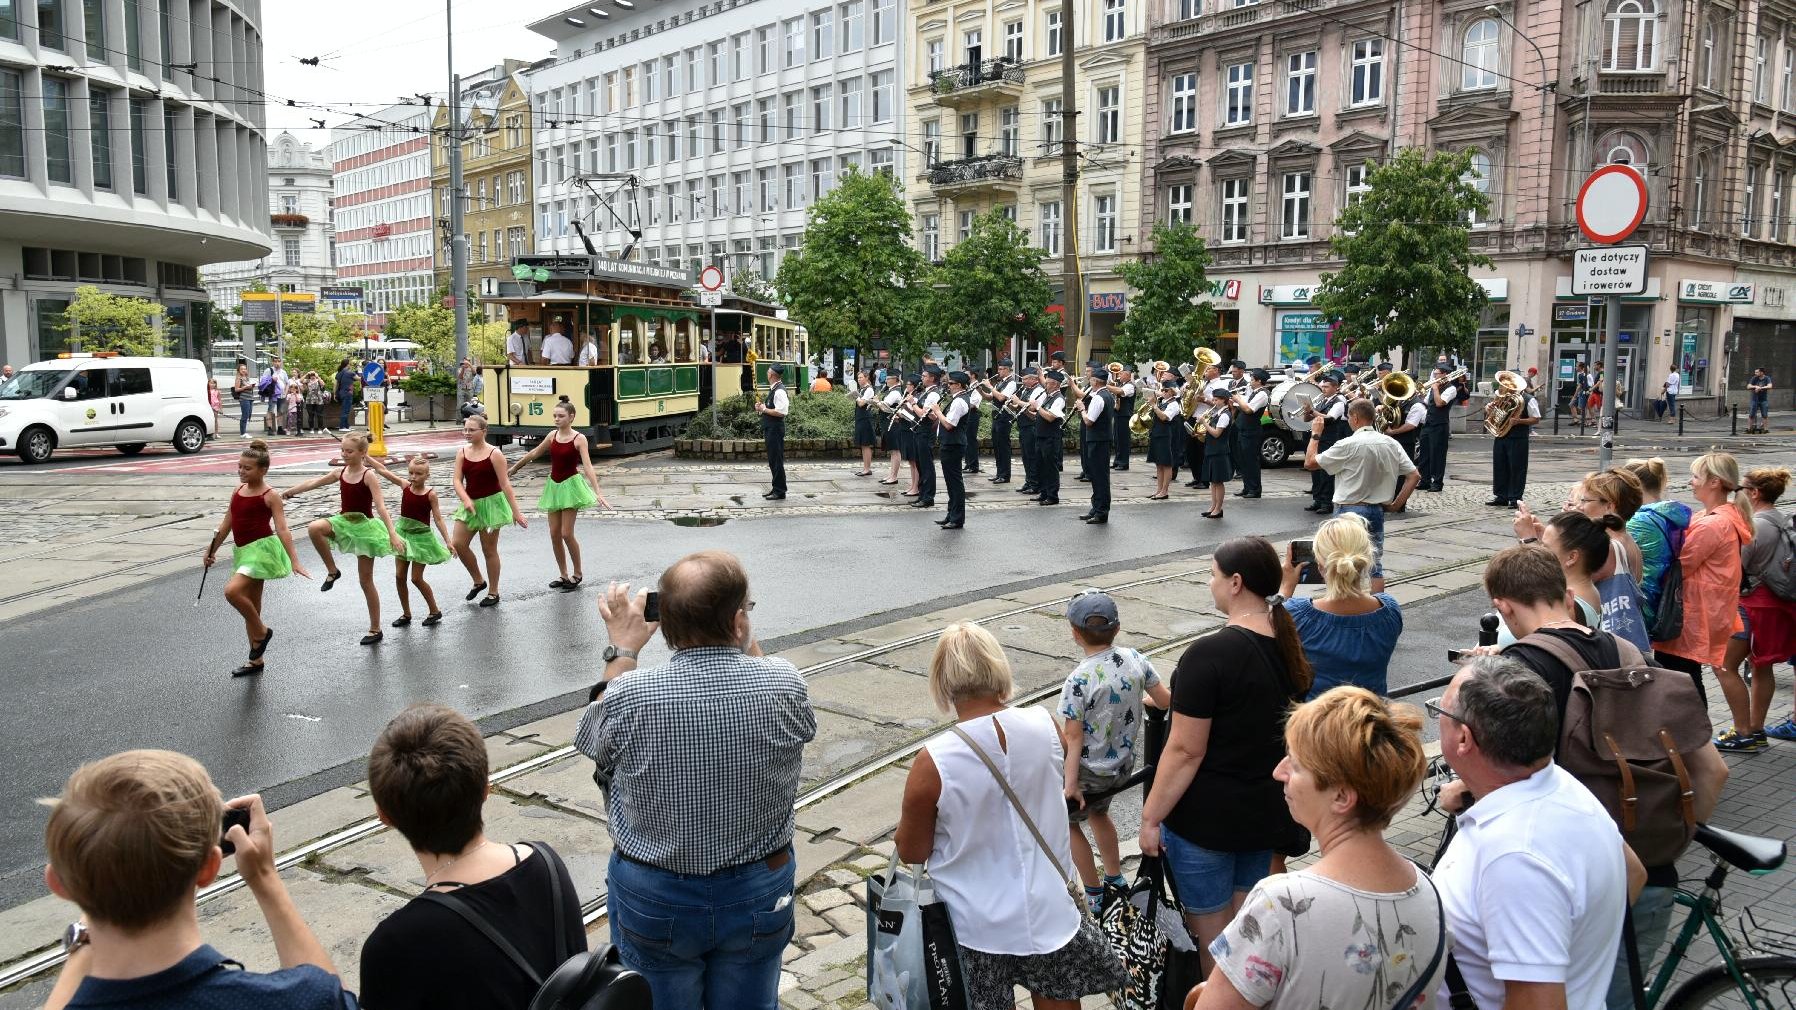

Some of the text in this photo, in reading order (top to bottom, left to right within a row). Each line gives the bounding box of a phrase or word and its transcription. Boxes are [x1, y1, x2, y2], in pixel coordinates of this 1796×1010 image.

[1580, 252, 1640, 265] Nie dotyczy
[597, 260, 607, 272] 140
[608, 261, 617, 273] LAT
[1590, 266, 1627, 277] dostaw
[486, 276, 492, 294] 1
[1583, 279, 1633, 290] i rowerów
[528, 402, 544, 416] 15
